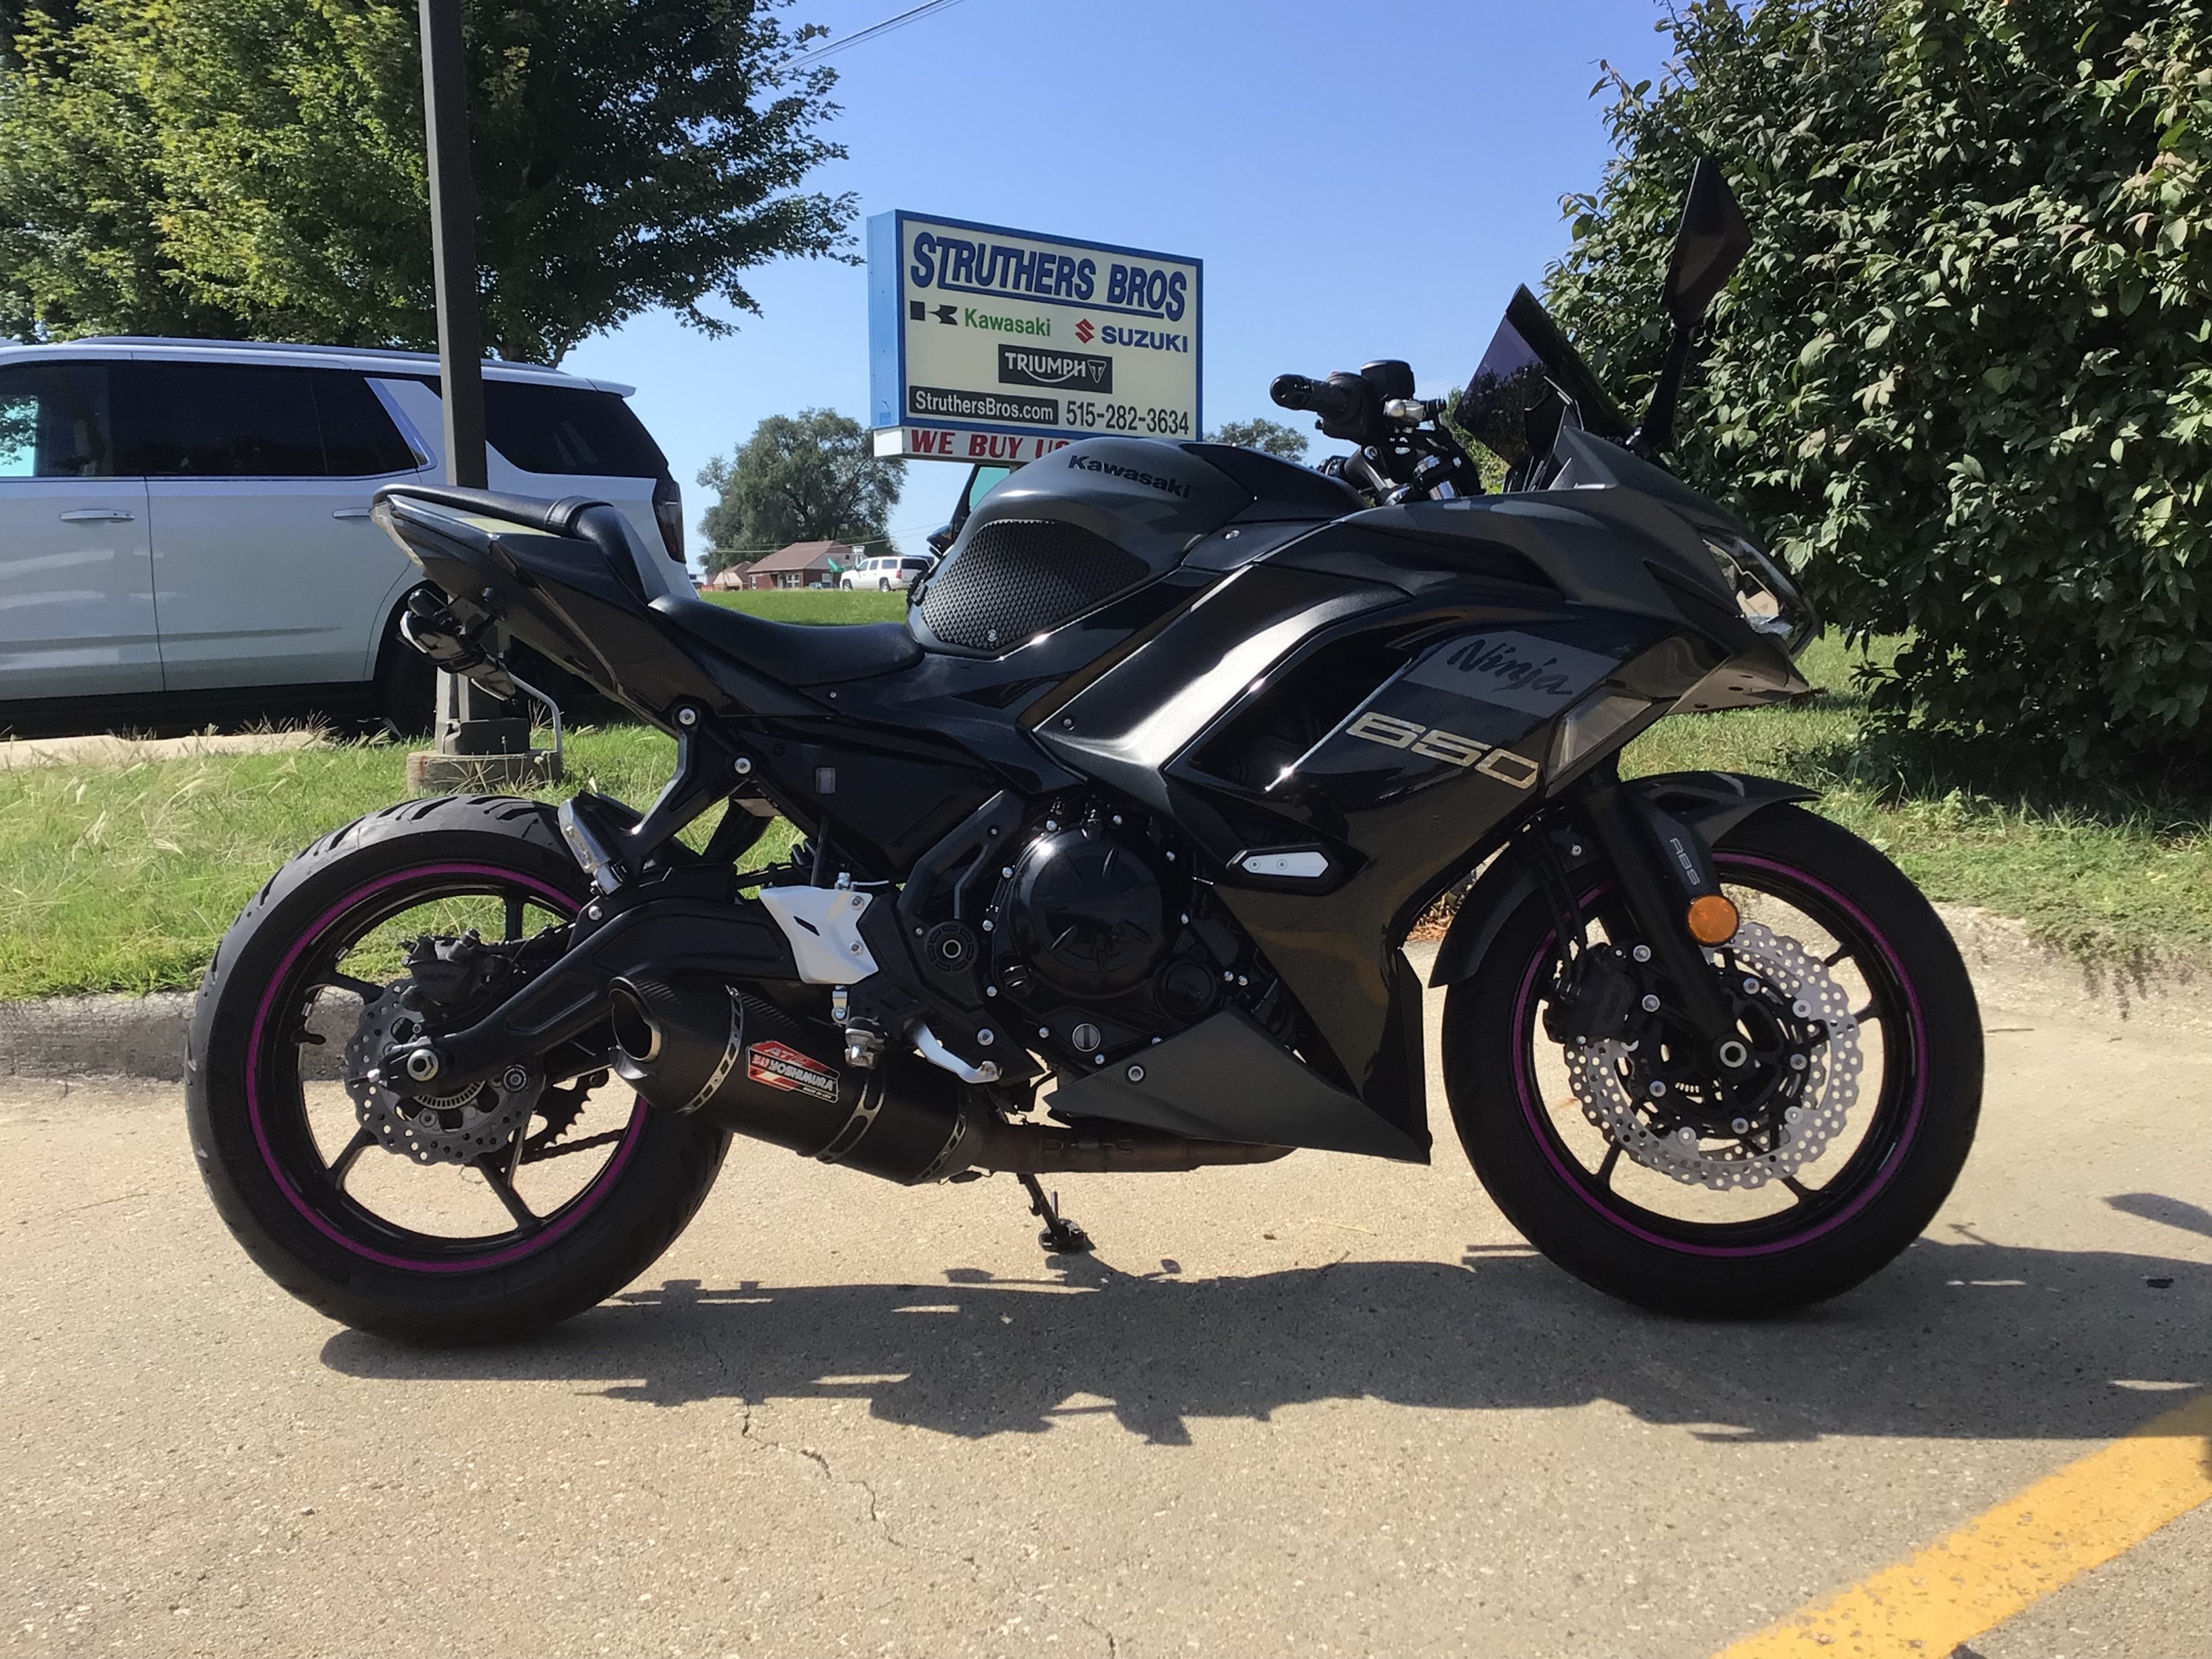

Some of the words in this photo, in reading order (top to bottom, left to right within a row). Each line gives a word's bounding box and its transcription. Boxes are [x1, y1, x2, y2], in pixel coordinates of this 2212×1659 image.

[910, 232, 1097, 301] STRUTHERS
[1107, 264, 1187, 322] BROS
[964, 308, 1051, 337] Kawasaki
[1101, 325, 1189, 353] SUZUKI
[1004, 352, 1086, 382] TRIUMPH
[915, 390, 1054, 422] StruthersBros.com
[1066, 401, 1189, 435] 515-282-3634
[911, 429, 956, 455] WE
[968, 434, 1023, 459] BUY
[1068, 455, 1191, 499] Kawasaki
[1446, 639, 1573, 696] Ninja
[1345, 712, 1540, 790] 650
[1669, 838, 1700, 885] ABS
[769, 1059, 834, 1092] YOSHIMURA
